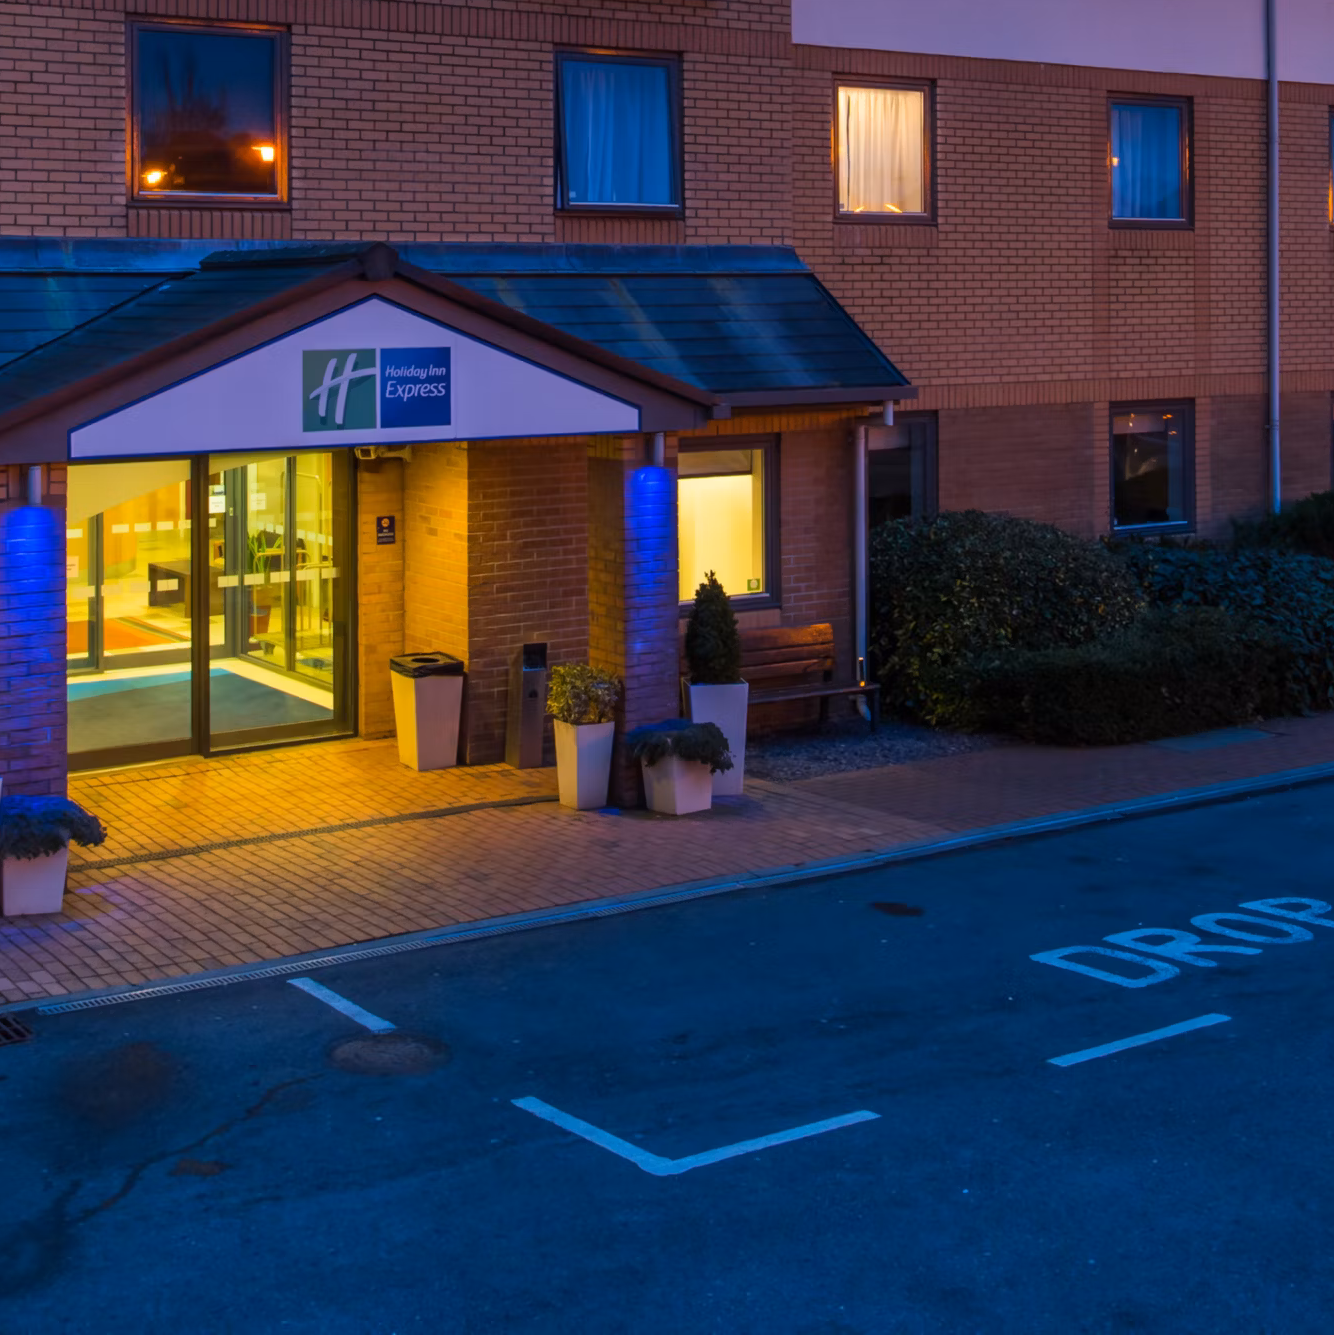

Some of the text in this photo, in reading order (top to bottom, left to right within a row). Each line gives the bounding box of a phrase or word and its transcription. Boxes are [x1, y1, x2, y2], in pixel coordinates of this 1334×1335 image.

[385, 364, 446, 379] Holiday Inn
[385, 380, 446, 402] Express
